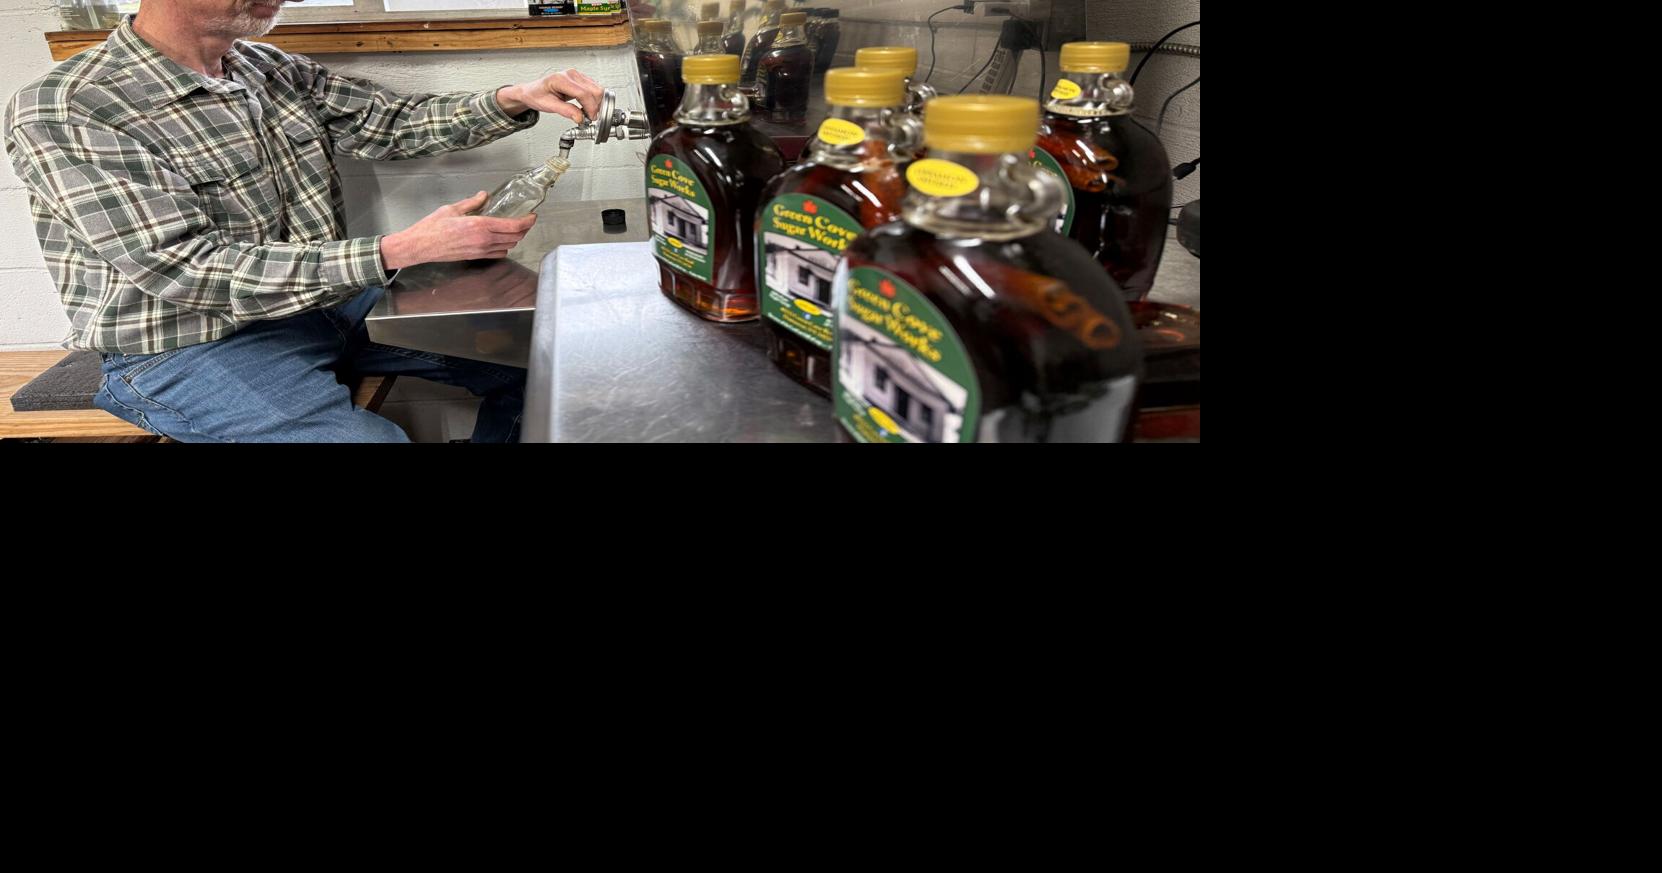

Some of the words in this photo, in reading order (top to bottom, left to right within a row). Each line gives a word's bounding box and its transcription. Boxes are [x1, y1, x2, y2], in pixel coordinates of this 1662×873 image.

[651, 165, 671, 178] Green
[671, 170, 695, 187] Cove
[651, 175, 669, 188] Sugar
[670, 179, 696, 197] Works
[773, 204, 813, 225] Green
[814, 216, 858, 241] Cove
[773, 216, 807, 236] Sugar
[808, 226, 849, 250] Work
[884, 314, 942, 362] Works
[891, 301, 943, 342] Cove
